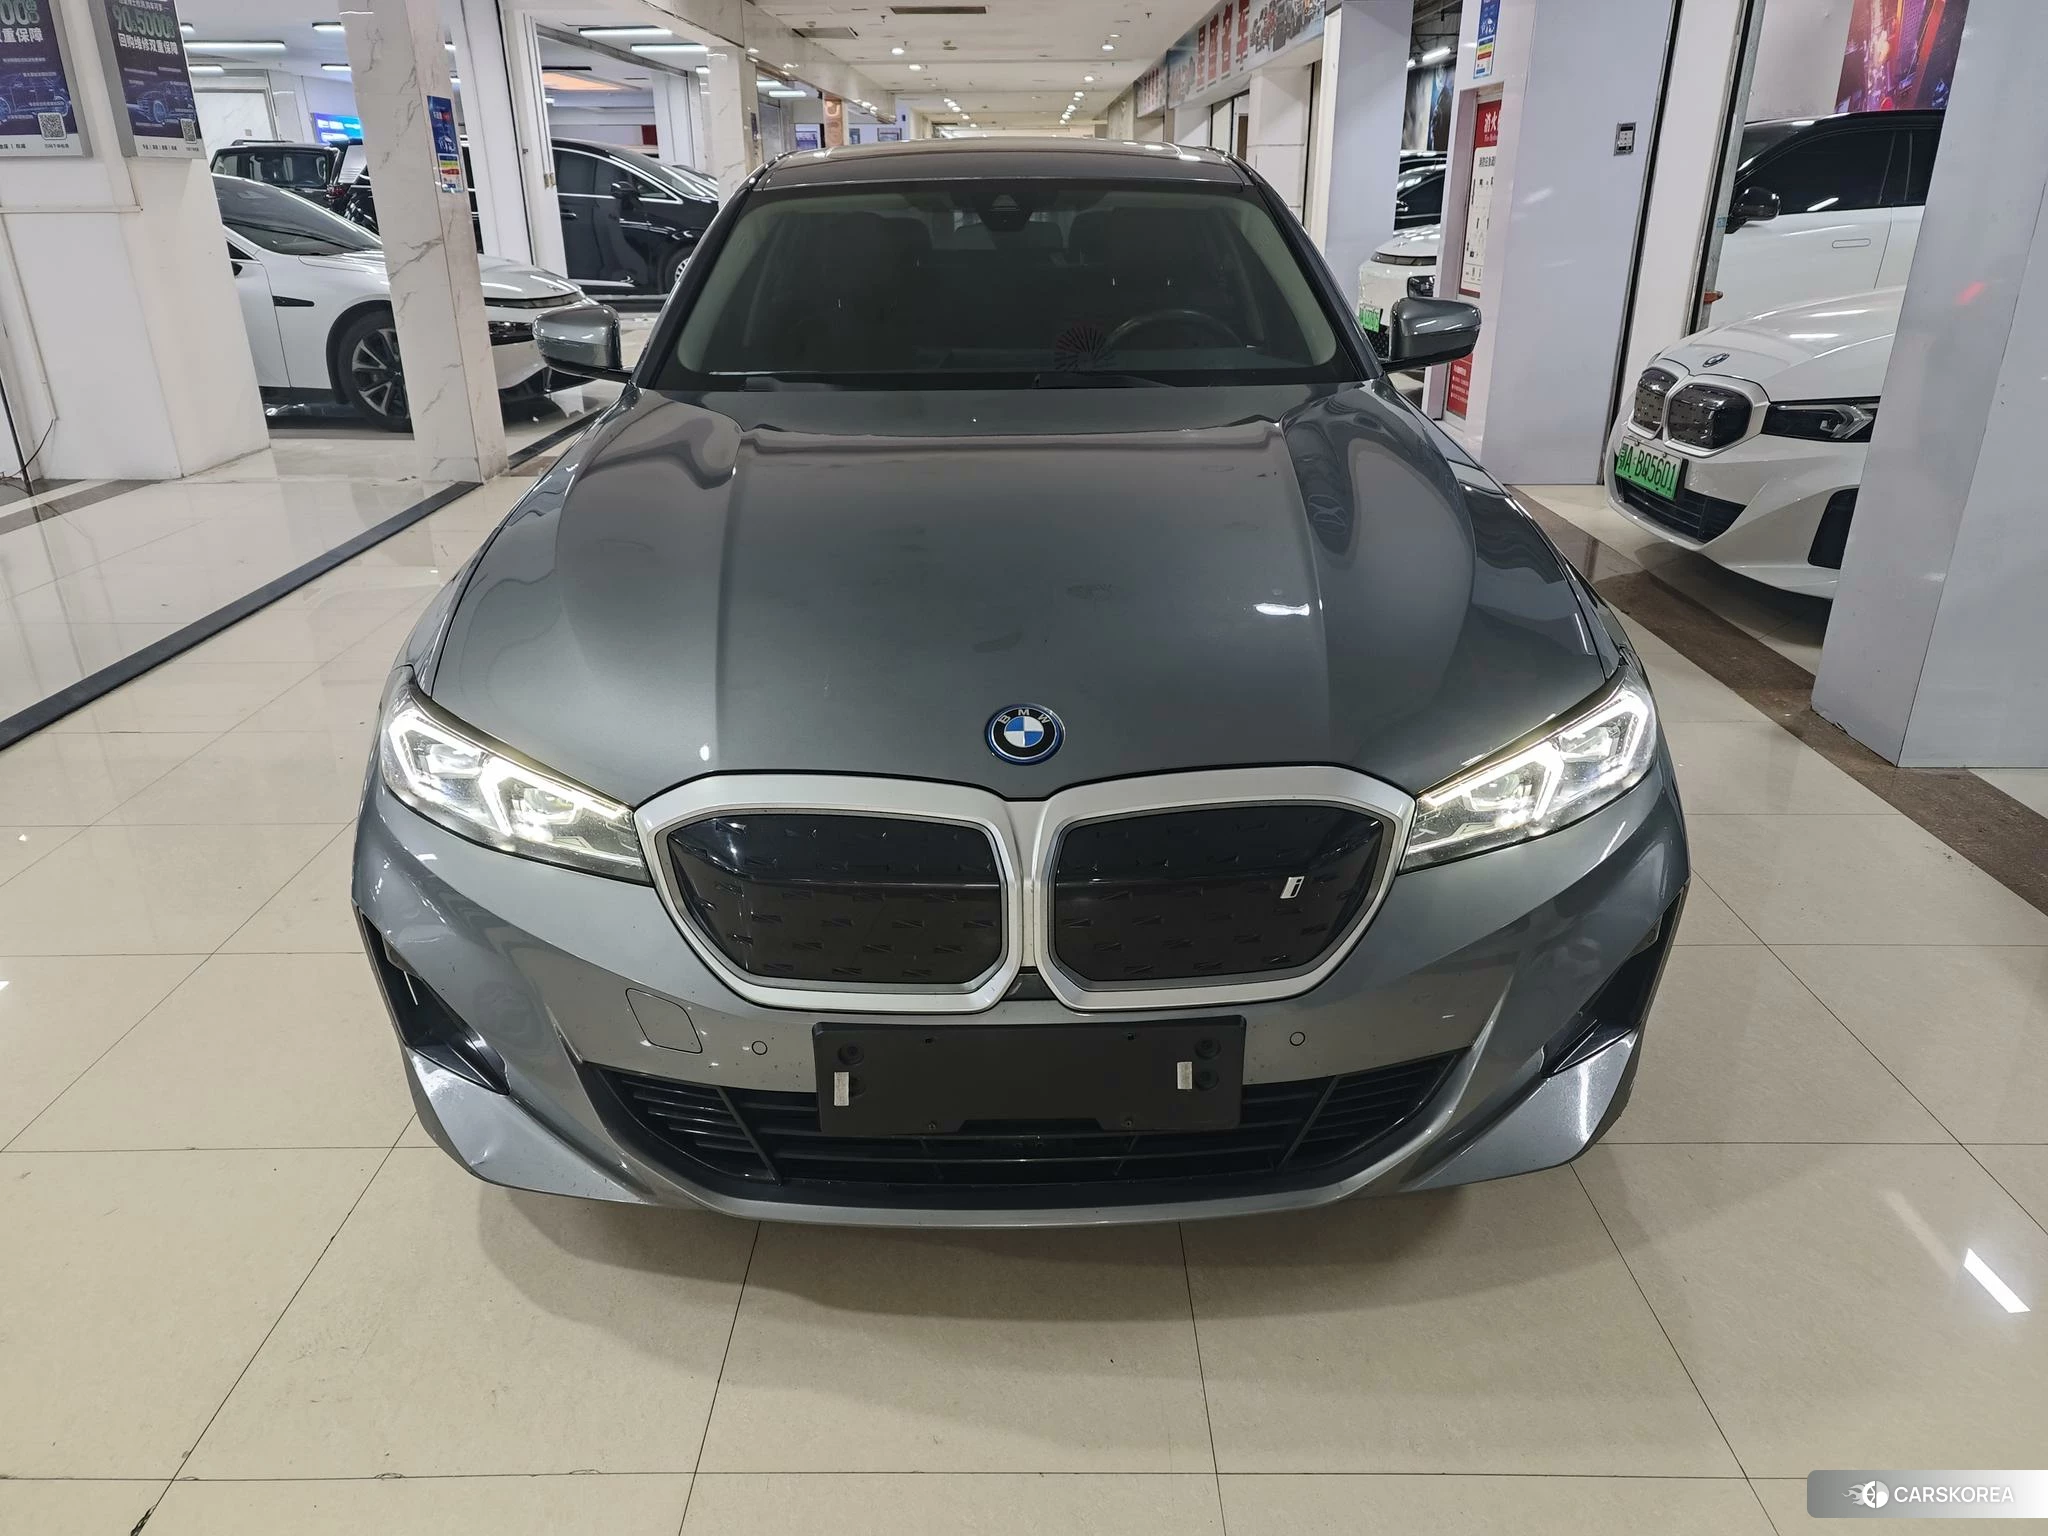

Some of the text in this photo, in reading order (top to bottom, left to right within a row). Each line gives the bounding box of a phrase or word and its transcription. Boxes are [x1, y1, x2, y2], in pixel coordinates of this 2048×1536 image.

[0, 27, 43, 43] 重保障
[998, 709, 1050, 724] BMW
